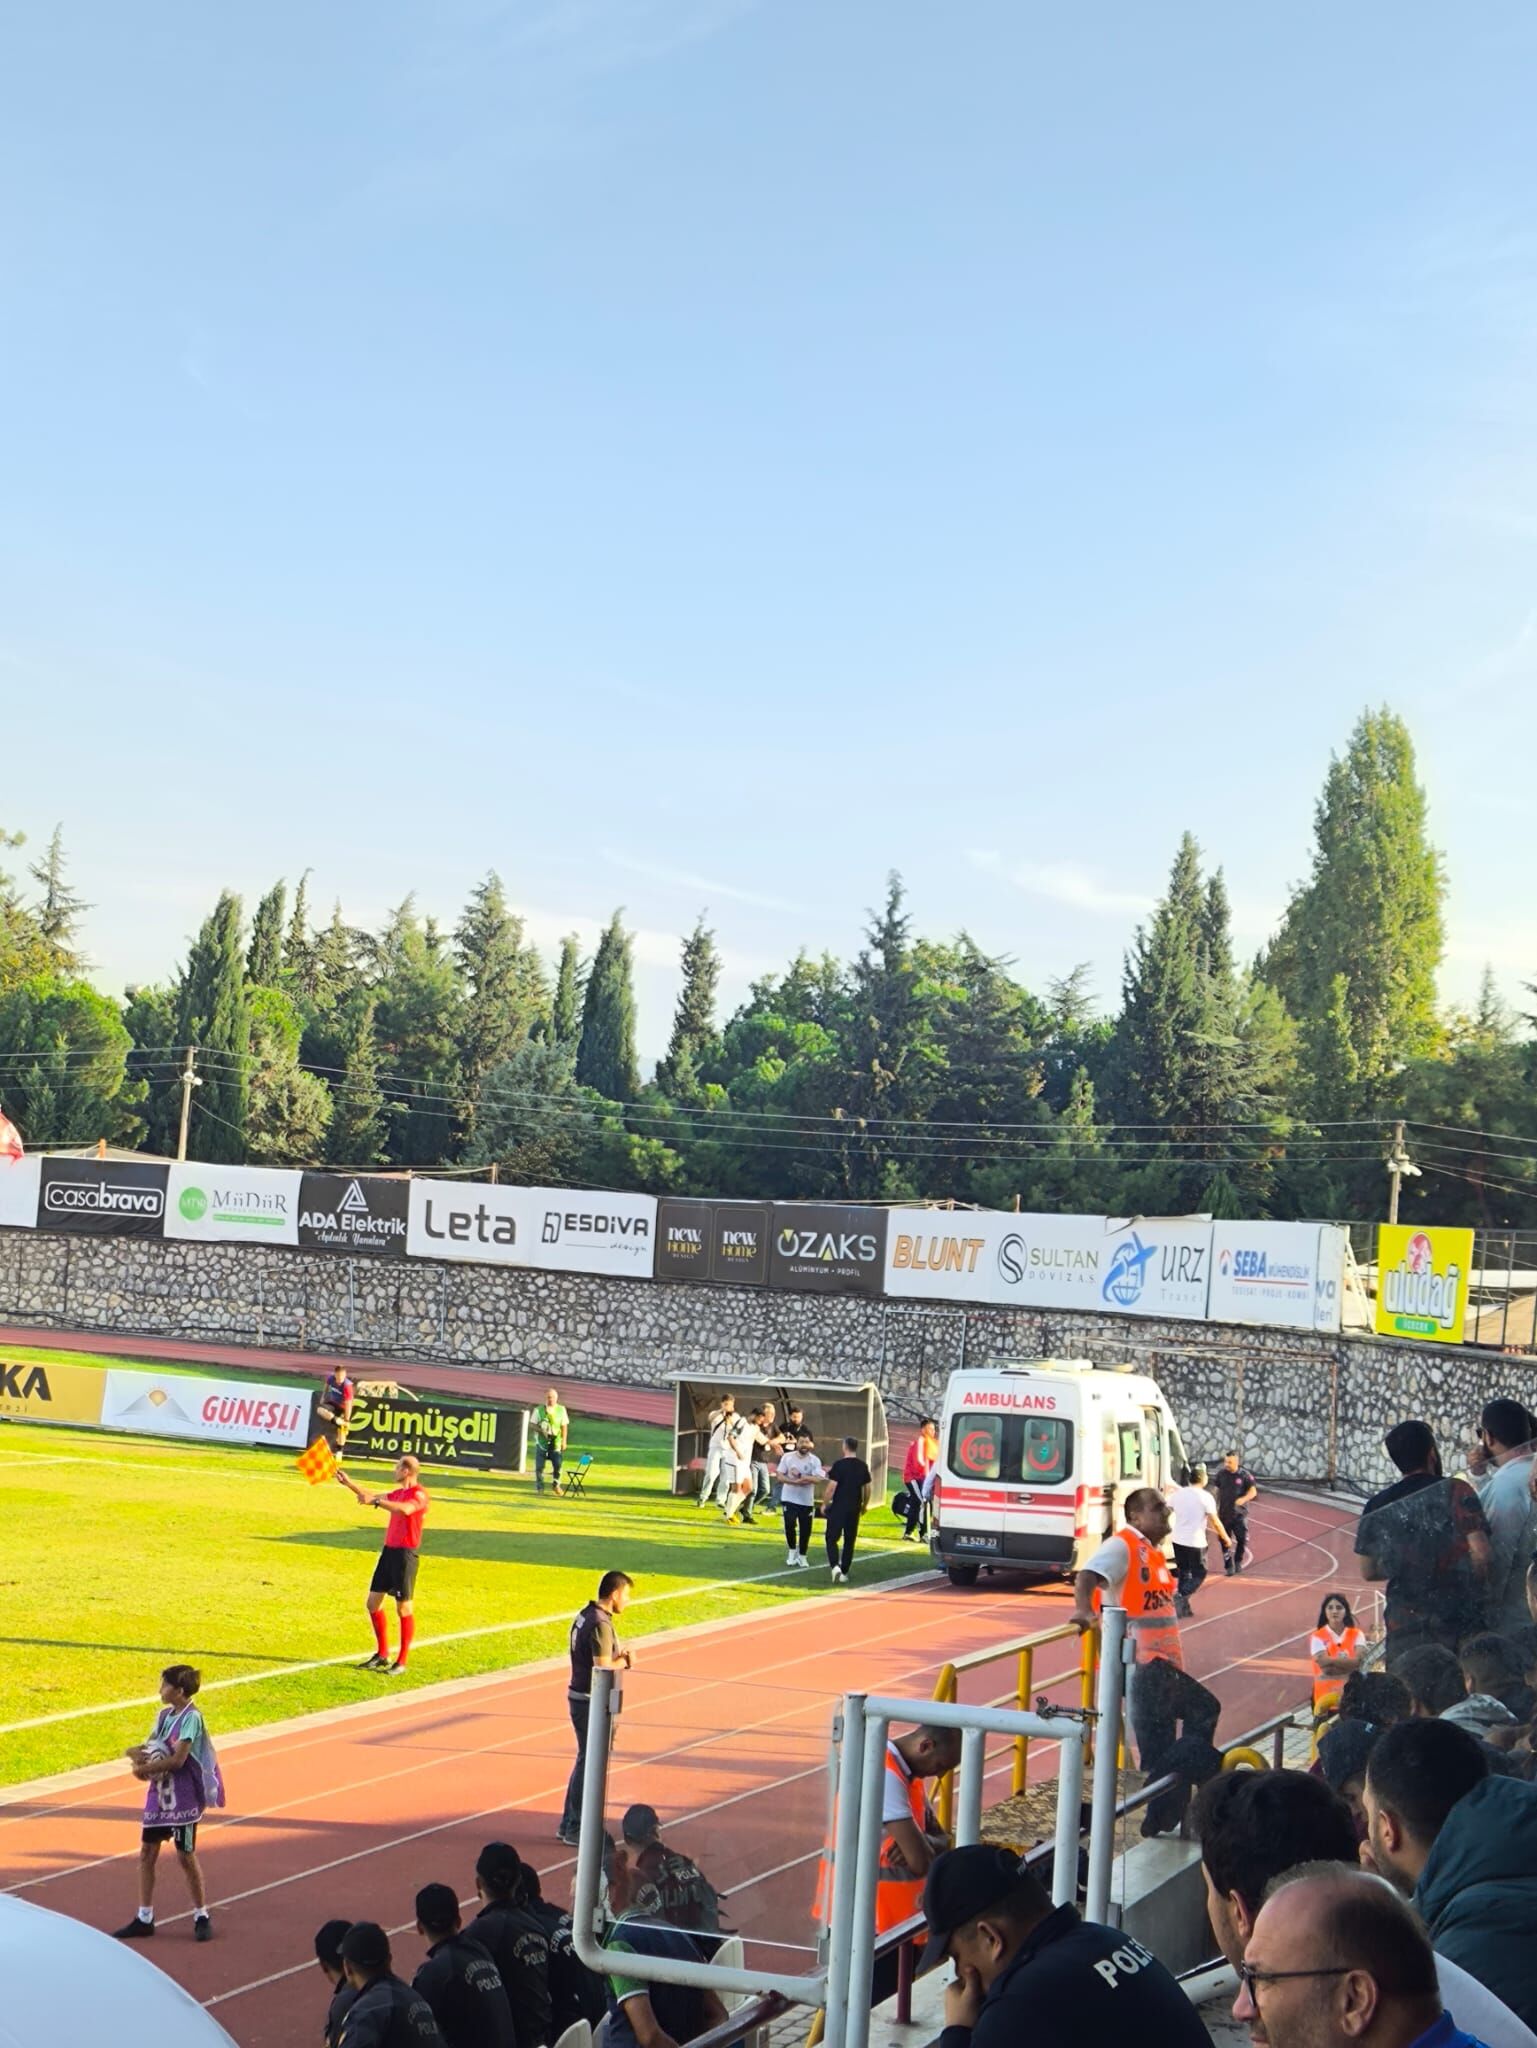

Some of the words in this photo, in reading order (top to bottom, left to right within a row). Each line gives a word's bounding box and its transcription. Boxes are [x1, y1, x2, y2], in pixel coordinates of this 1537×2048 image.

[50, 1181, 159, 1212] casabrava
[298, 1211, 338, 1229] ADA
[341, 1213, 407, 1235] Elektrik
[425, 1199, 516, 1245] Leta
[893, 1235, 985, 1273] BLUNT
[1030, 1248, 1099, 1269] SULTAN
[1233, 1250, 1267, 1278] SEBA
[963, 1392, 1057, 1410] AMBULANS
[349, 1399, 497, 1443] Gümüşdil
[371, 1437, 457, 1458] MOBİLYA
